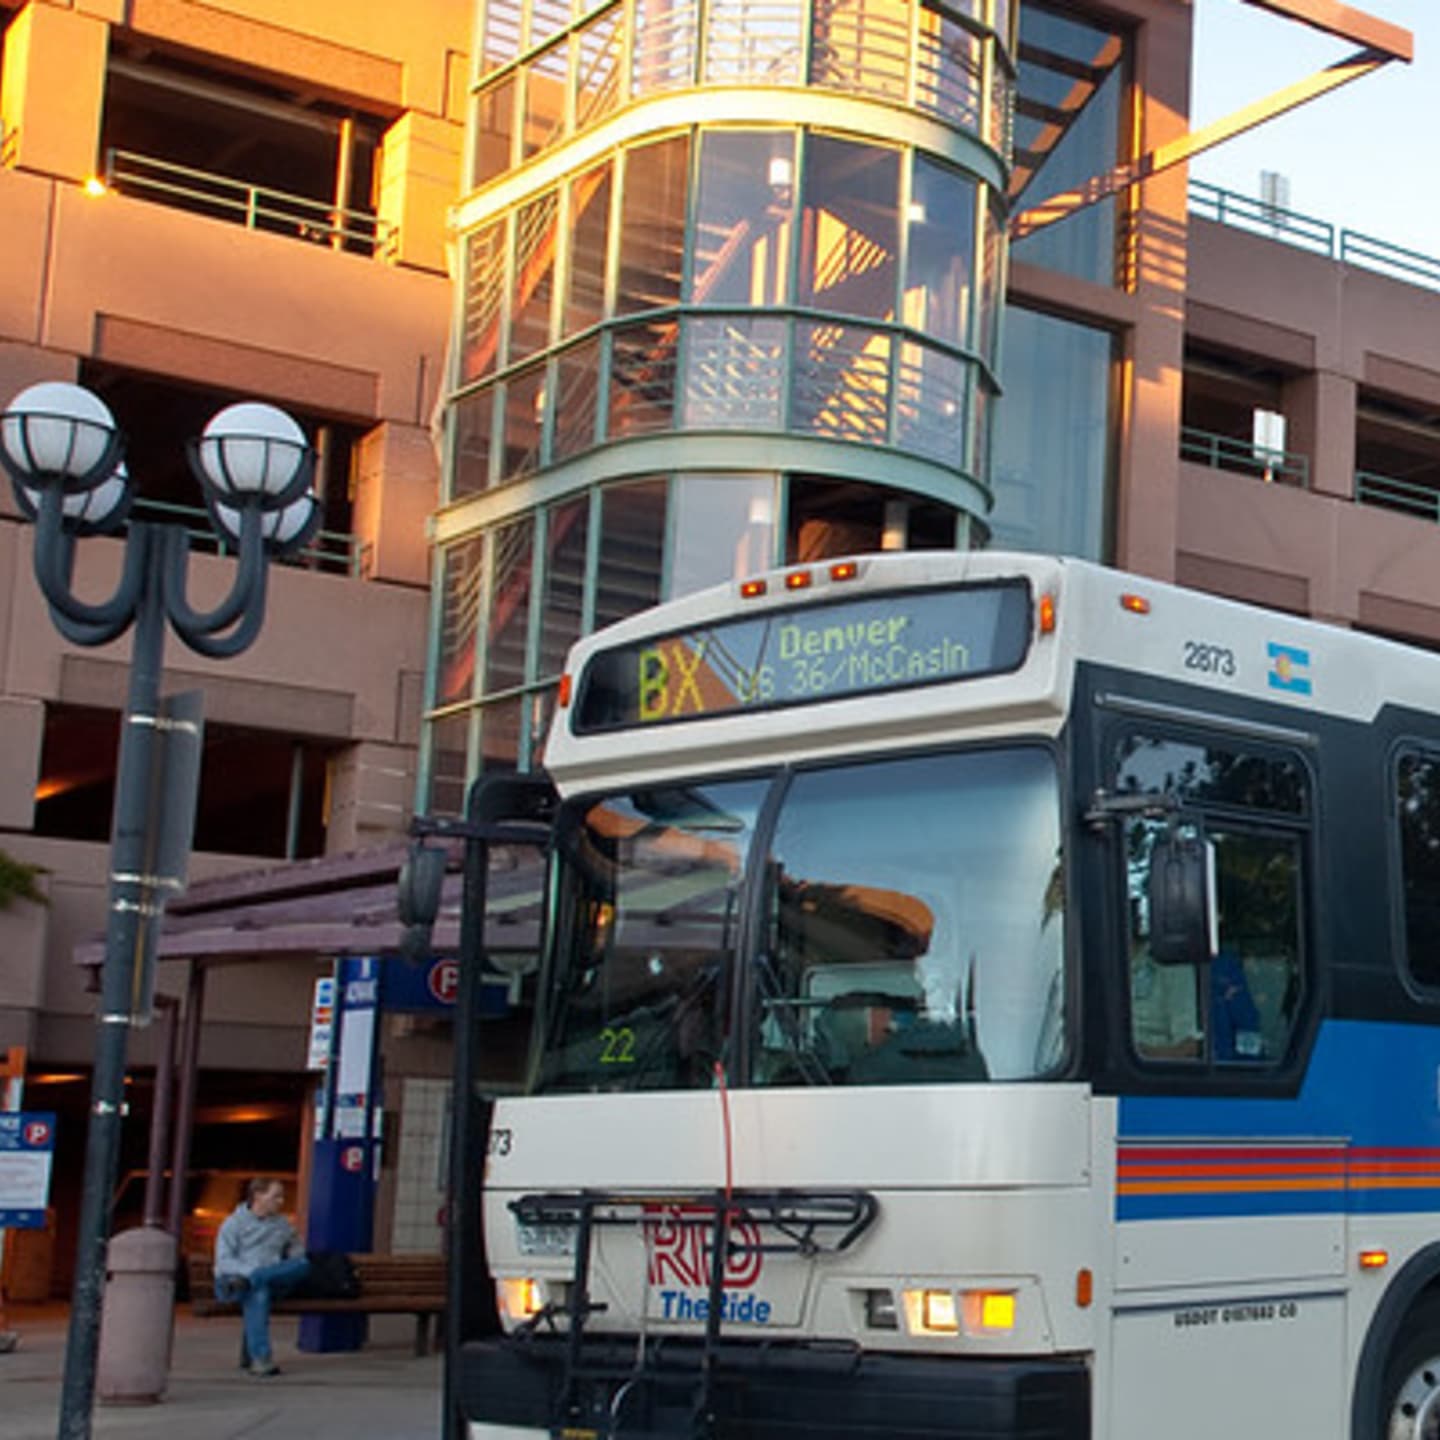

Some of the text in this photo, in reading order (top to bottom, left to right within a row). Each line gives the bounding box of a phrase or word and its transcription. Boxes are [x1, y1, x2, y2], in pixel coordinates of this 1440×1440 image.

[779, 615, 908, 660] Denver
[1184, 641, 1237, 676] 2873
[638, 639, 707, 720] BX
[600, 1027, 636, 1063] 22
